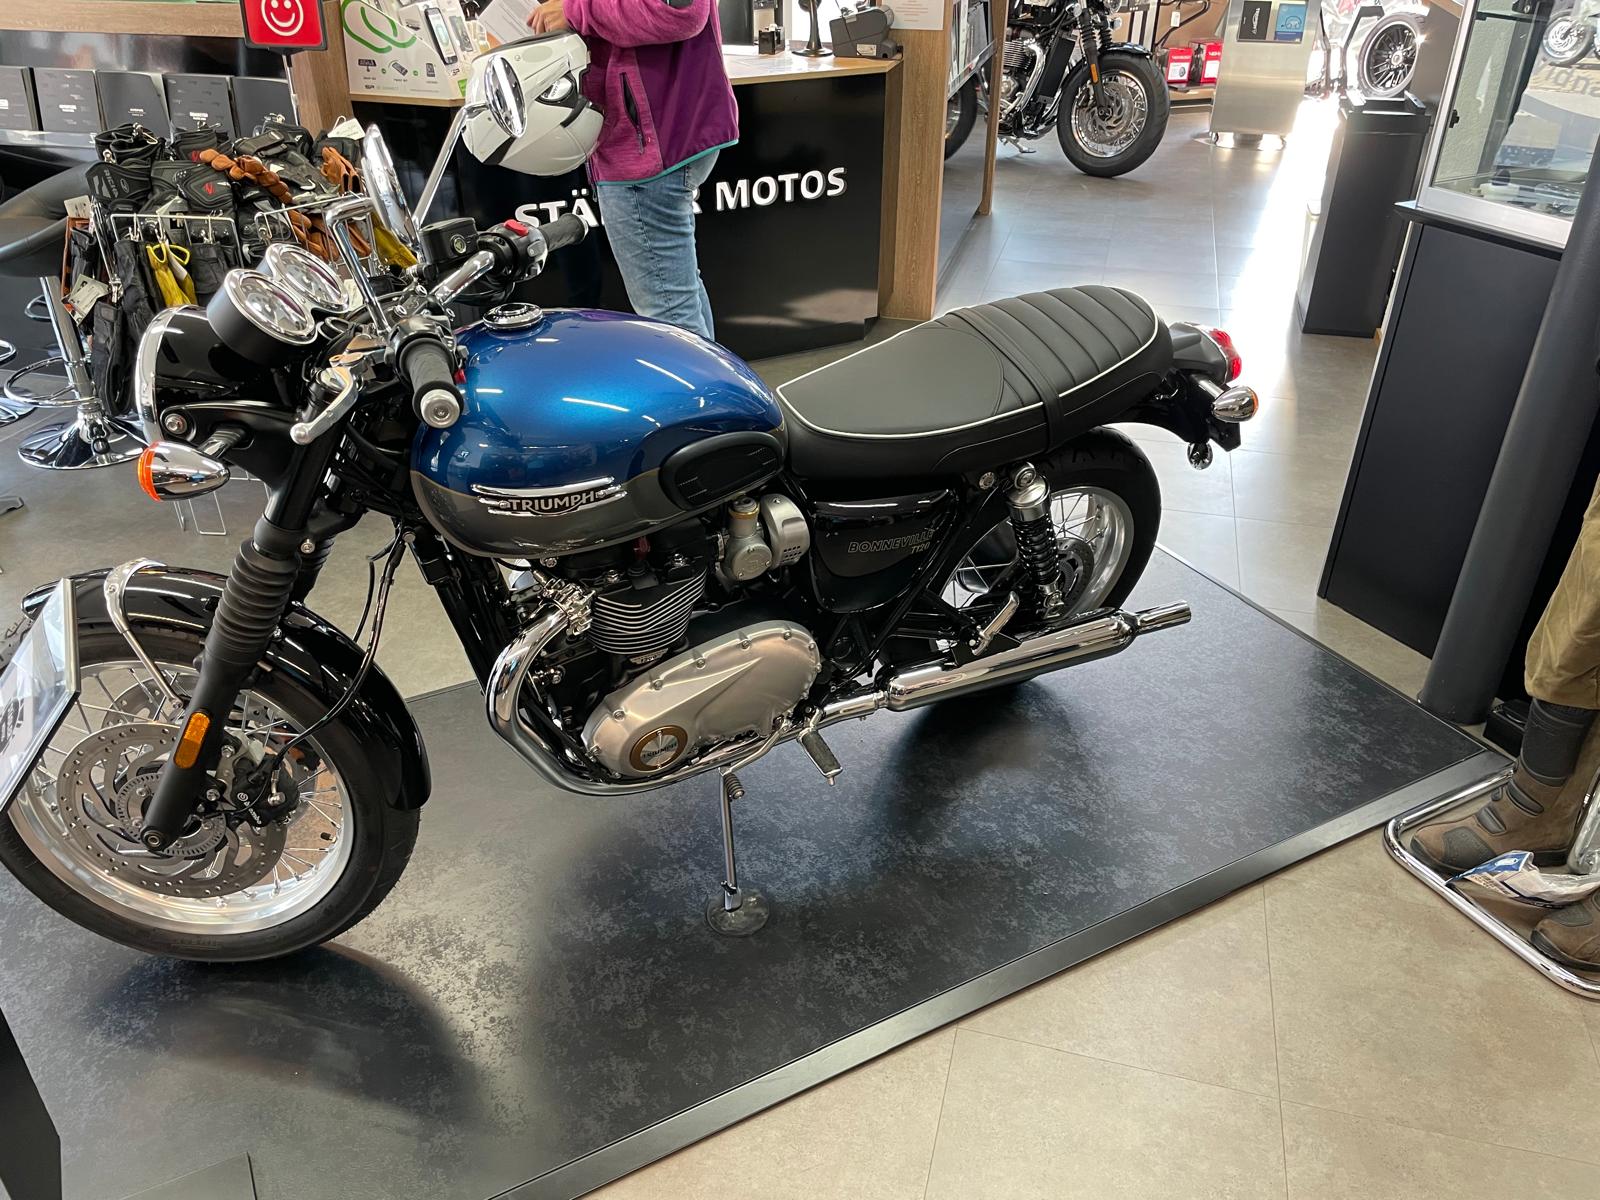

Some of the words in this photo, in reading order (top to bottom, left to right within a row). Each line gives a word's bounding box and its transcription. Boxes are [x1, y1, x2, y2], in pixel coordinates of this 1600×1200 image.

[715, 166, 848, 211] MOTOS
[507, 490, 595, 516] TRIUMPH
[847, 529, 934, 553] BONNEVILLE
[911, 541, 931, 554] T120
